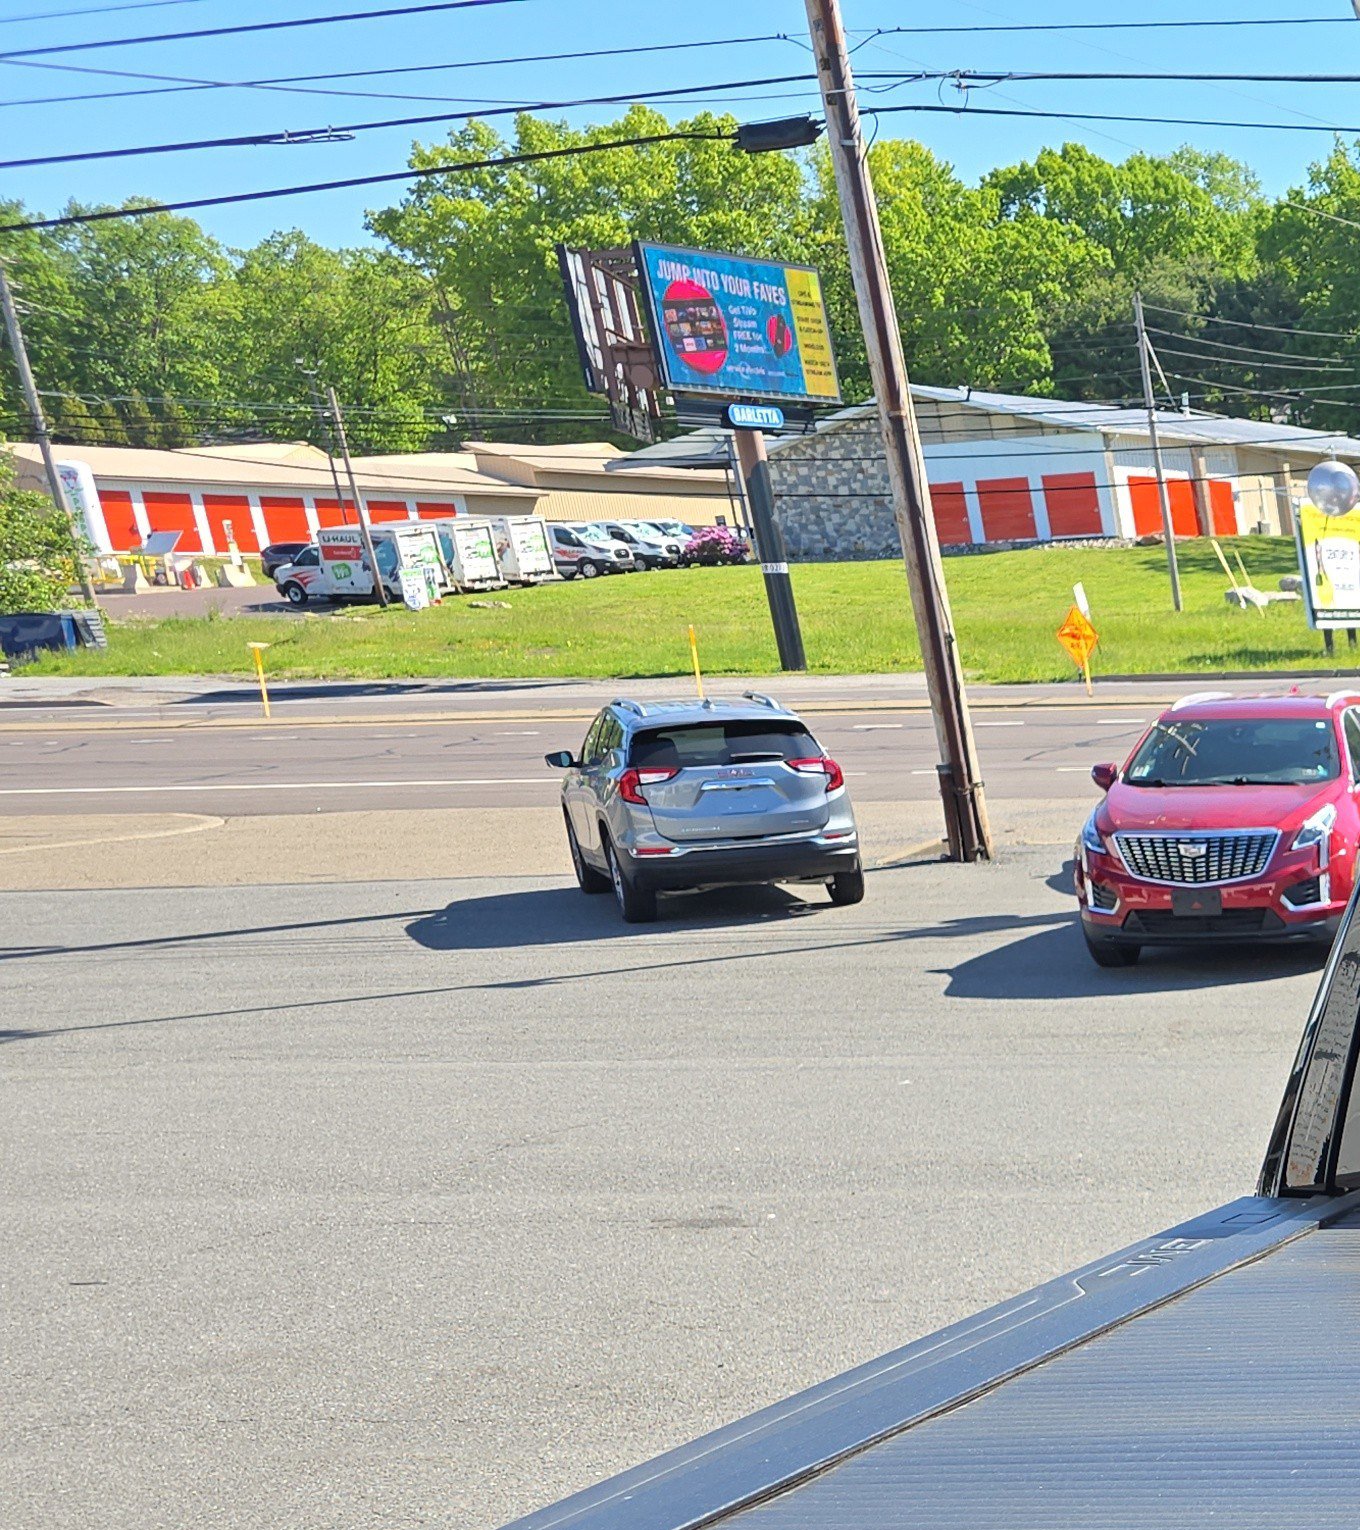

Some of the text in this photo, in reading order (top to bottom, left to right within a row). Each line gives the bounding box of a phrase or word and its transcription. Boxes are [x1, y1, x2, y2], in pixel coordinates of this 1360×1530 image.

[657, 259, 787, 307] JUMP INTO YOUR FAVES
[733, 406, 779, 424] BARLETTA
